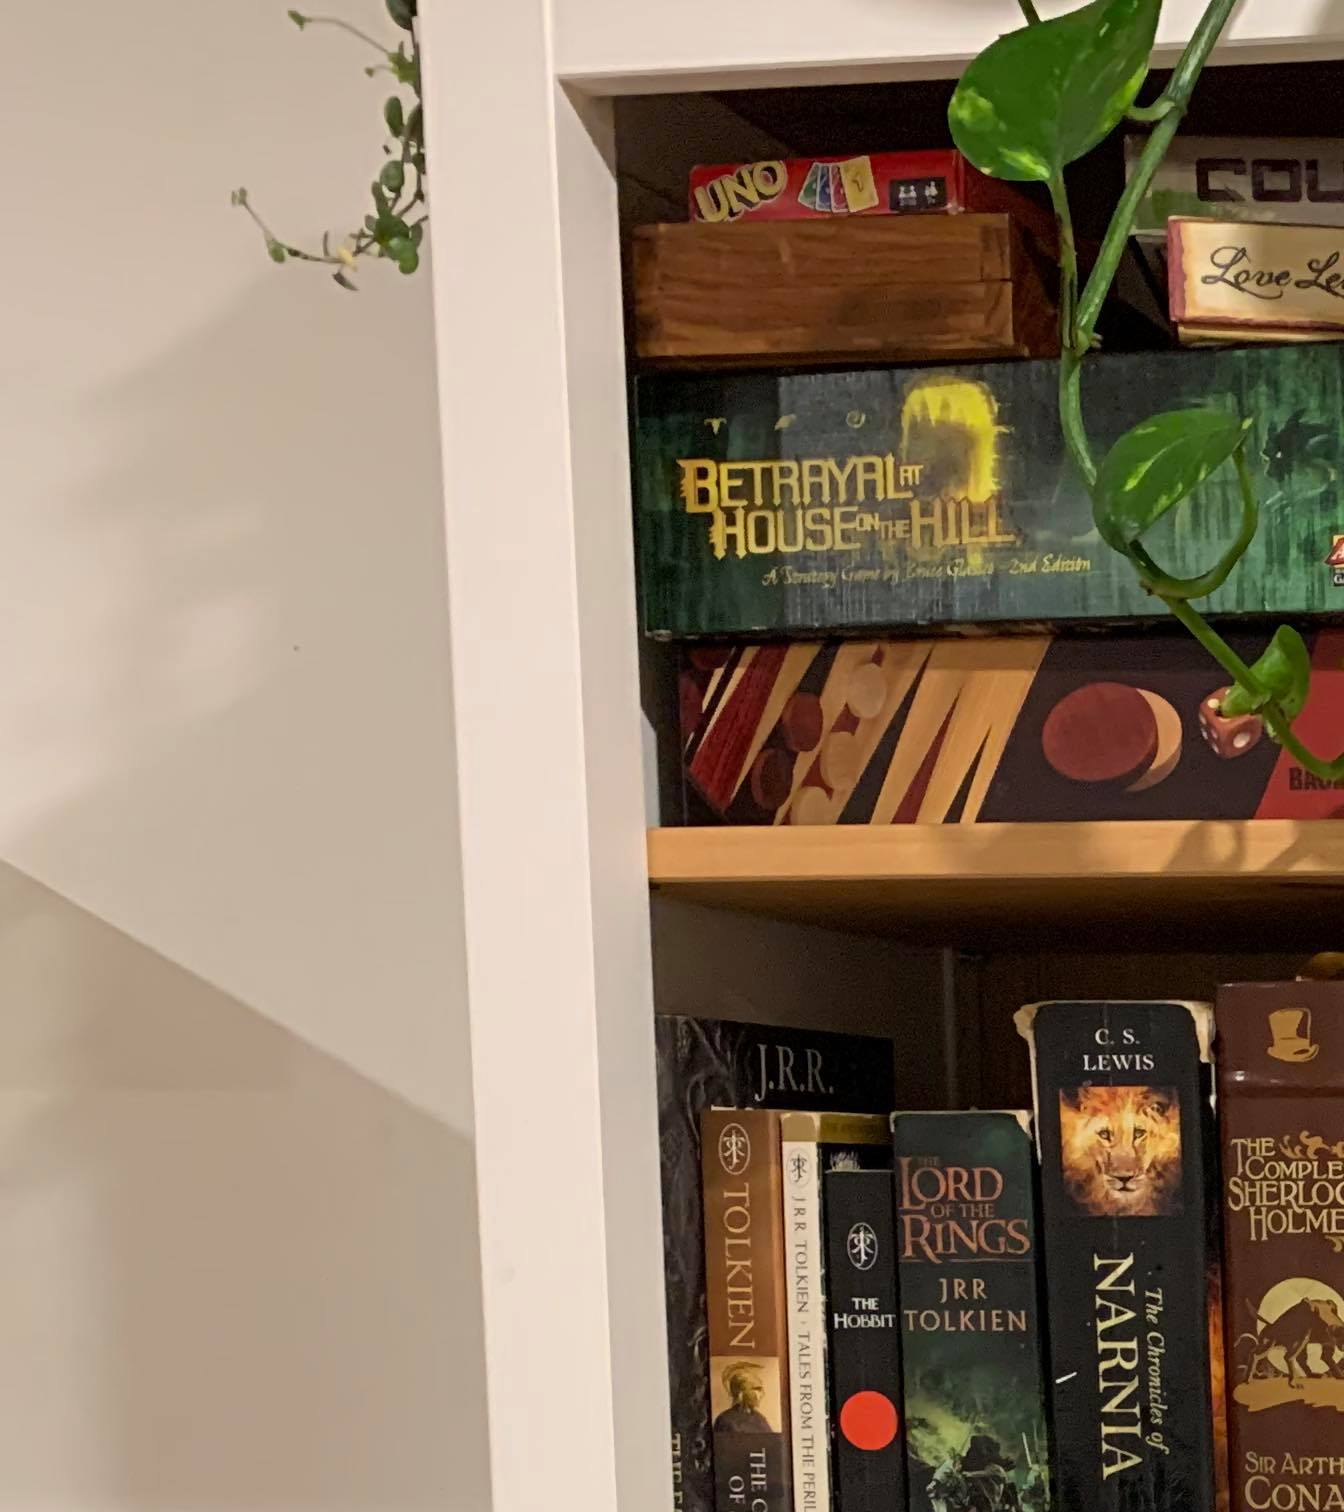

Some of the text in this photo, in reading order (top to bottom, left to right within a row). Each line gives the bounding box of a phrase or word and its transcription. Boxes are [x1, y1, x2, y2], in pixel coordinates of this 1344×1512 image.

[694, 160, 788, 222] UNO
[1200, 246, 1292, 299] Love
[676, 453, 924, 513] BETRAYAL AT
[708, 502, 861, 560] HOUSE
[856, 515, 880, 532] ON
[910, 496, 1017, 549] HILL
[1094, 1028, 1141, 1046] C. S.
[1082, 1054, 1155, 1072] LEWIS
[1230, 1137, 1276, 1174] THE
[896, 1156, 1004, 1210] LORD
[930, 1203, 995, 1218] OF THE
[900, 1213, 1031, 1265] RINGS
[723, 1182, 756, 1350] TOLKIEN
[795, 1239, 810, 1313] TOLKIEN
[833, 1313, 897, 1330] HOBBIT
[851, 1298, 880, 1311] THE
[903, 1309, 1027, 1332] TOLKIEN
[798, 1330, 812, 1379] TALES
[1093, 1251, 1144, 1481] NARNIA
[1145, 1287, 1170, 1456] The Chronicles of
[800, 1383, 813, 1430] FROM
[747, 1447, 767, 1492] THE
[801, 1434, 815, 1468] THE
[1245, 1451, 1276, 1474] SIR
[728, 1475, 747, 1503] OF
